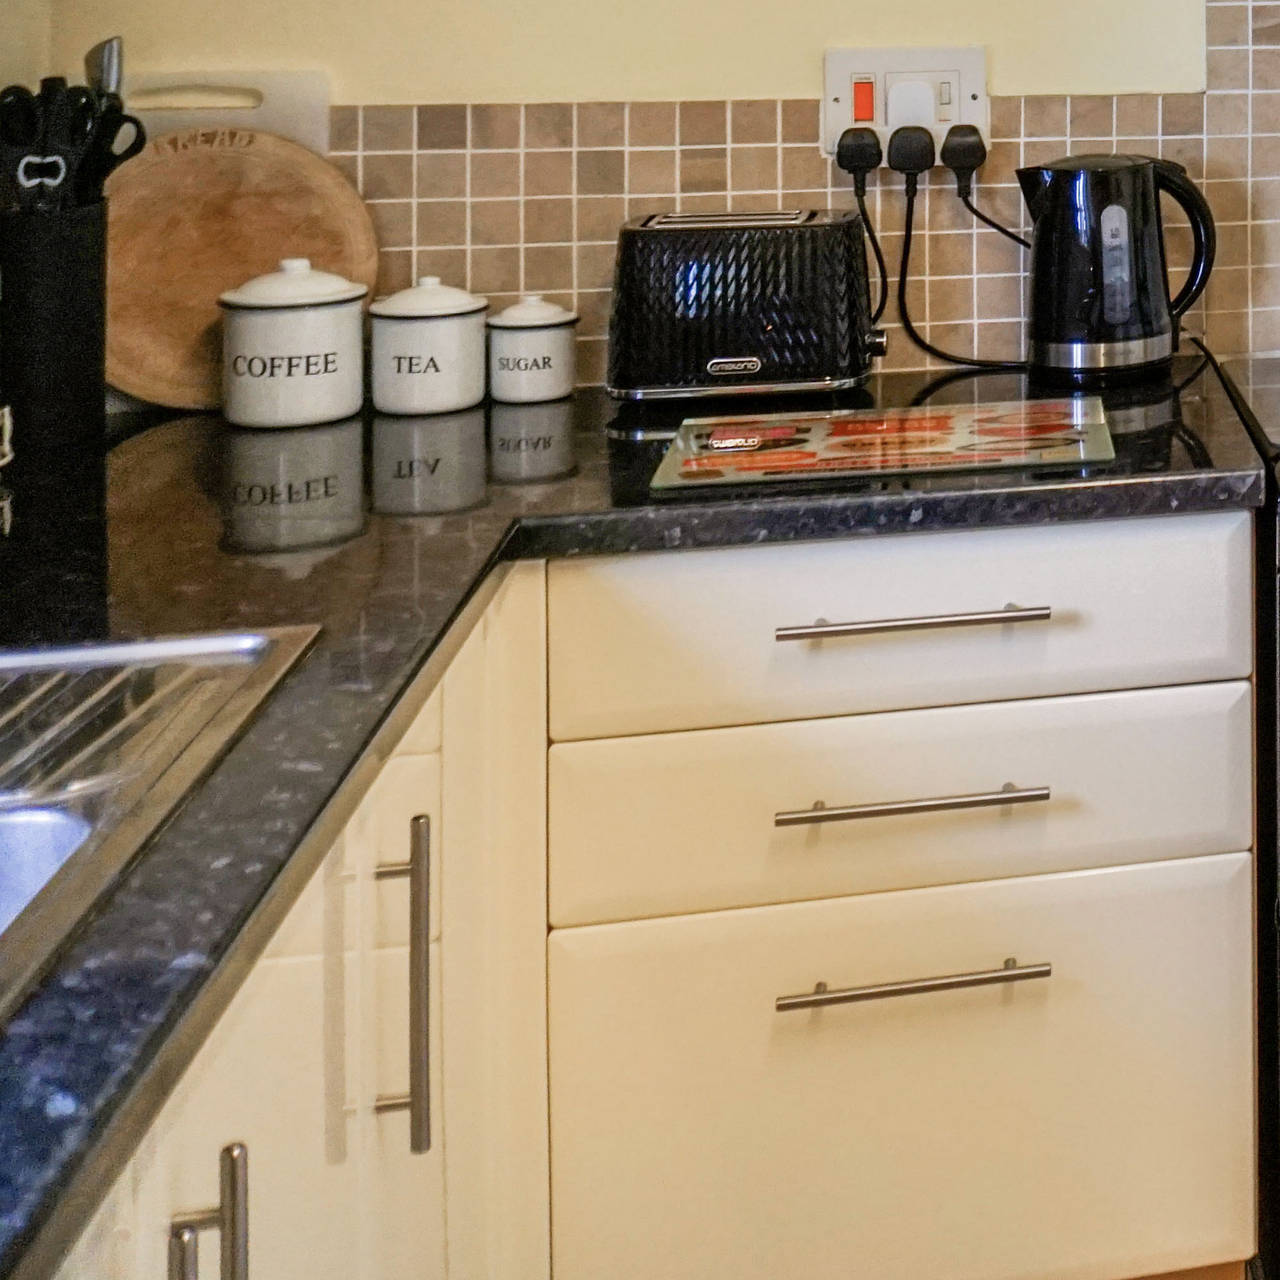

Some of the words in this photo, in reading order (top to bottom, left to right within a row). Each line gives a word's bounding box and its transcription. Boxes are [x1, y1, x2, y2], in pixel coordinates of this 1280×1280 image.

[232, 351, 338, 378] COFFEE
[391, 355, 441, 374] TEA
[497, 355, 553, 371] SUGAR
